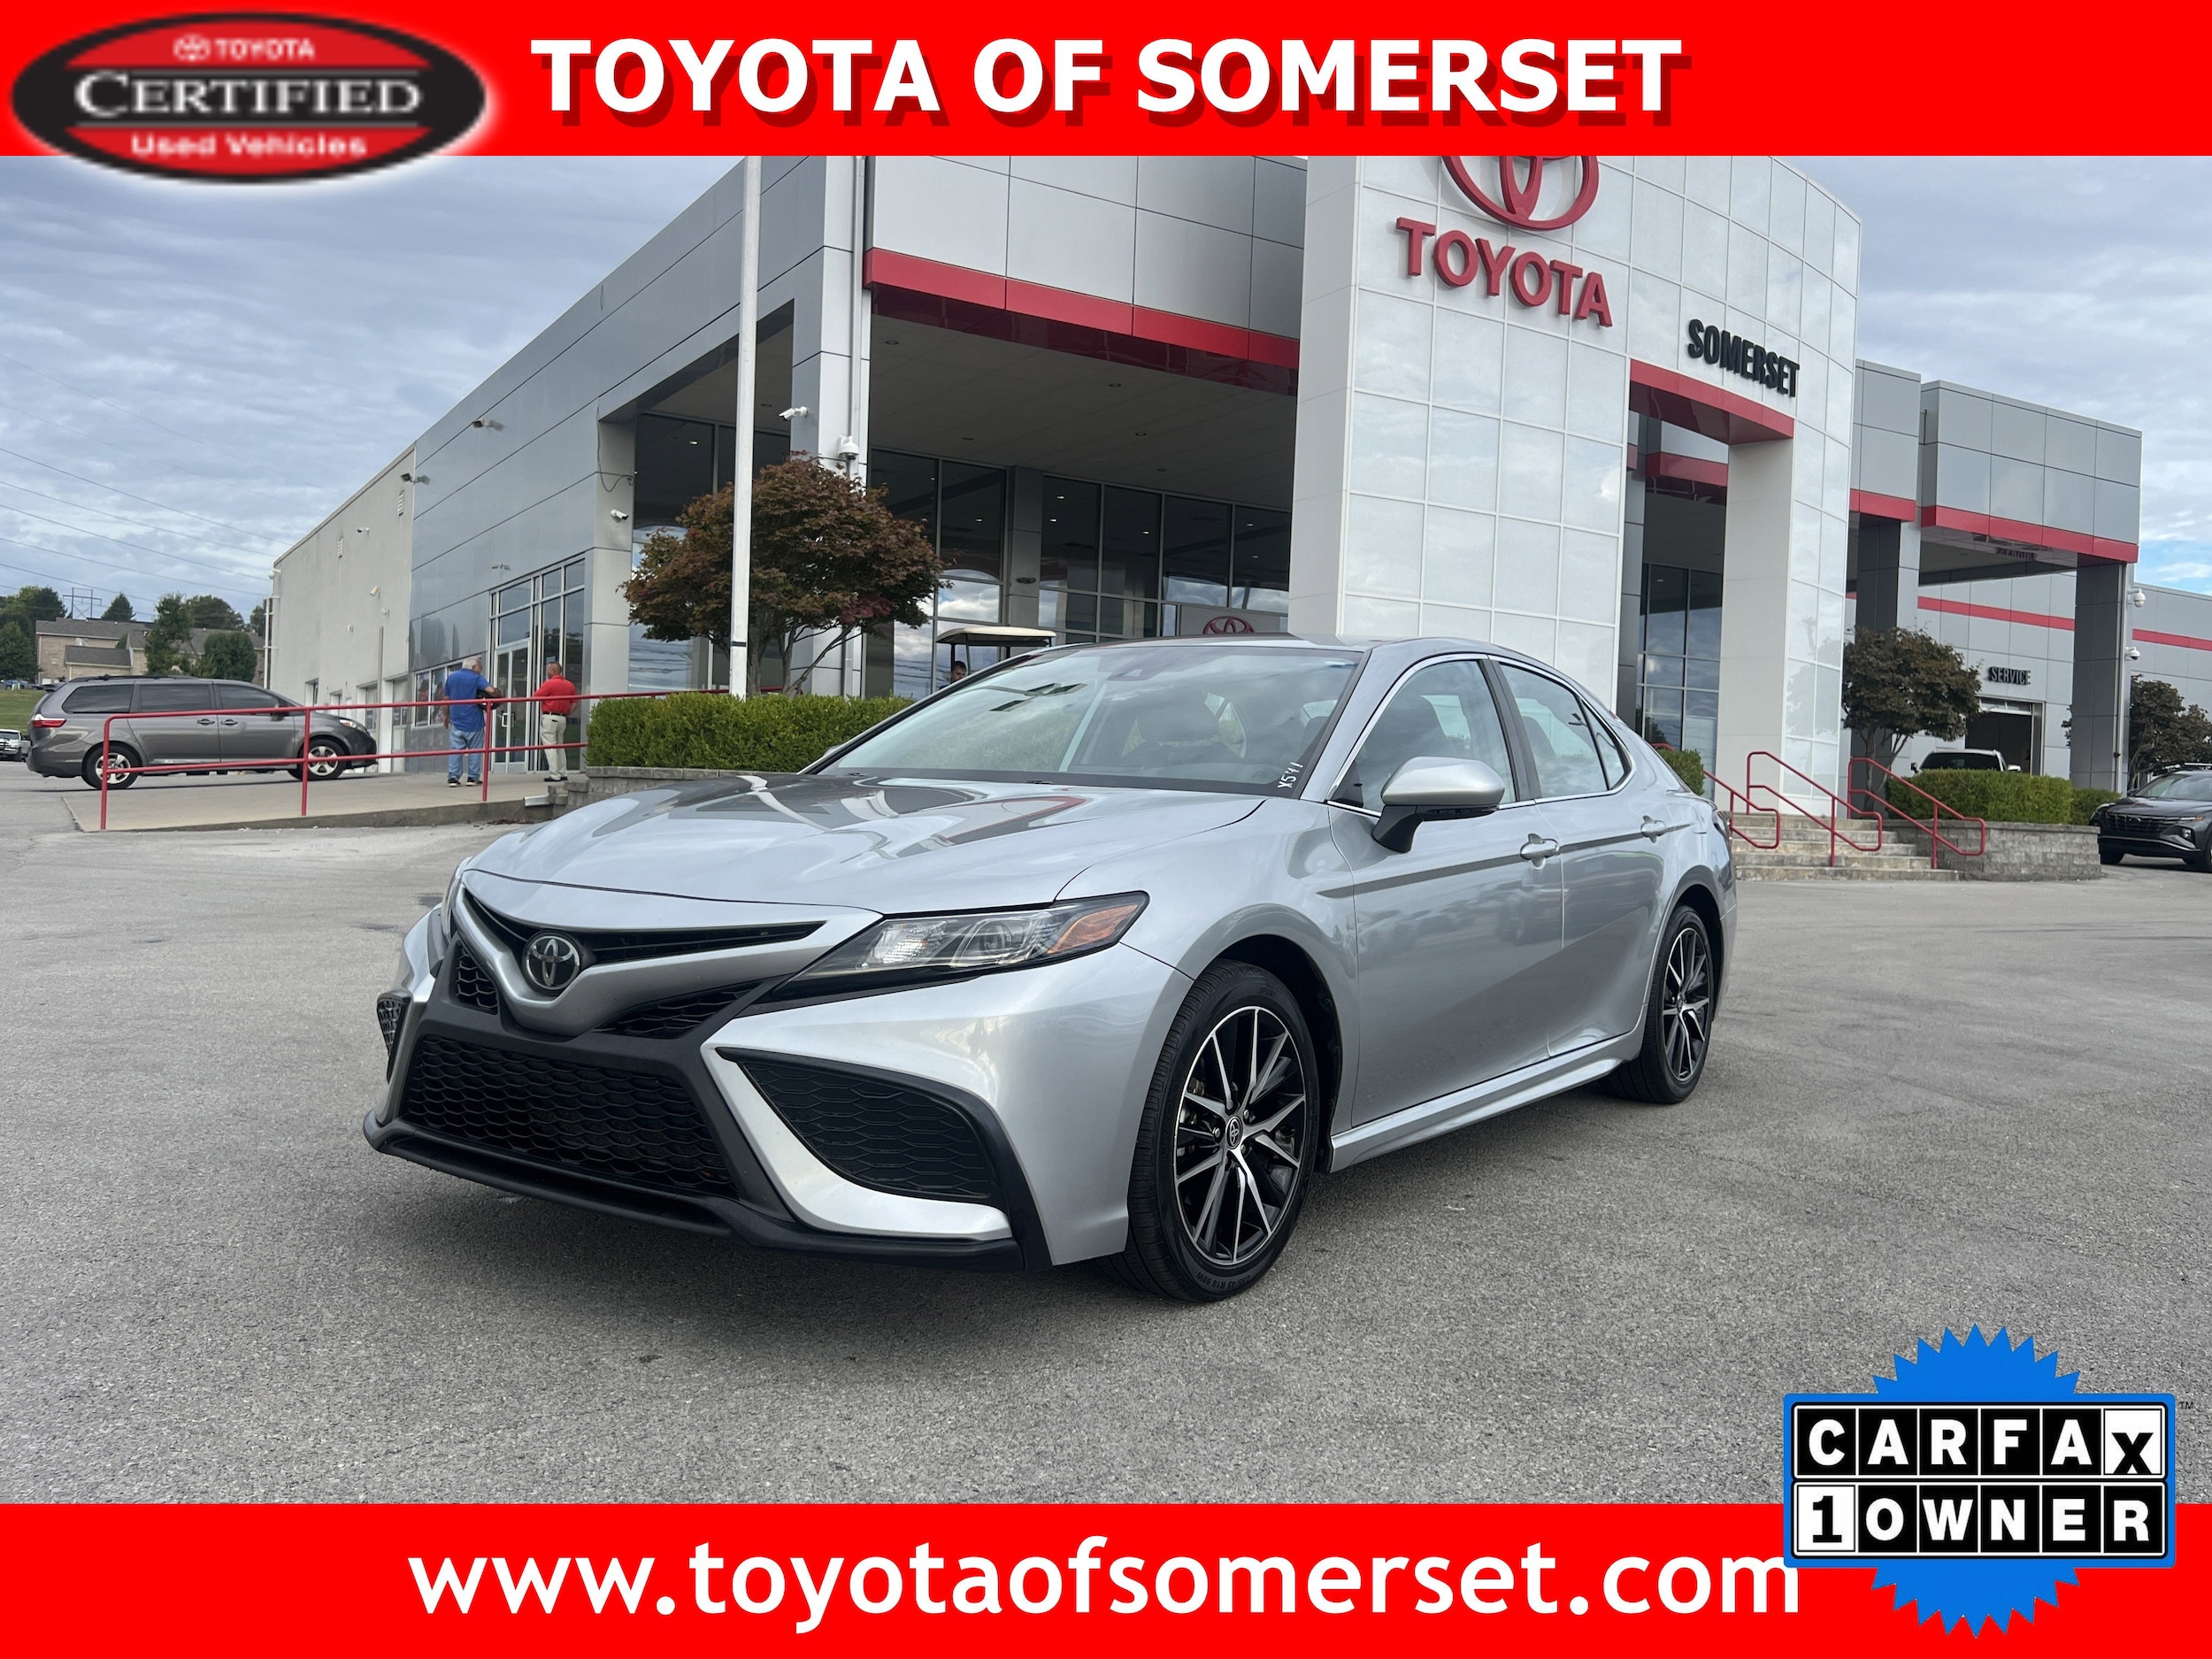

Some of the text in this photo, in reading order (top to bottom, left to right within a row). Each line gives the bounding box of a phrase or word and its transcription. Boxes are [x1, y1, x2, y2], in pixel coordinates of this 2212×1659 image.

[1395, 216, 1613, 327] TOYOTA
[1688, 319, 1800, 397] SOMERSET
[1988, 666, 2031, 685] SERVICE
